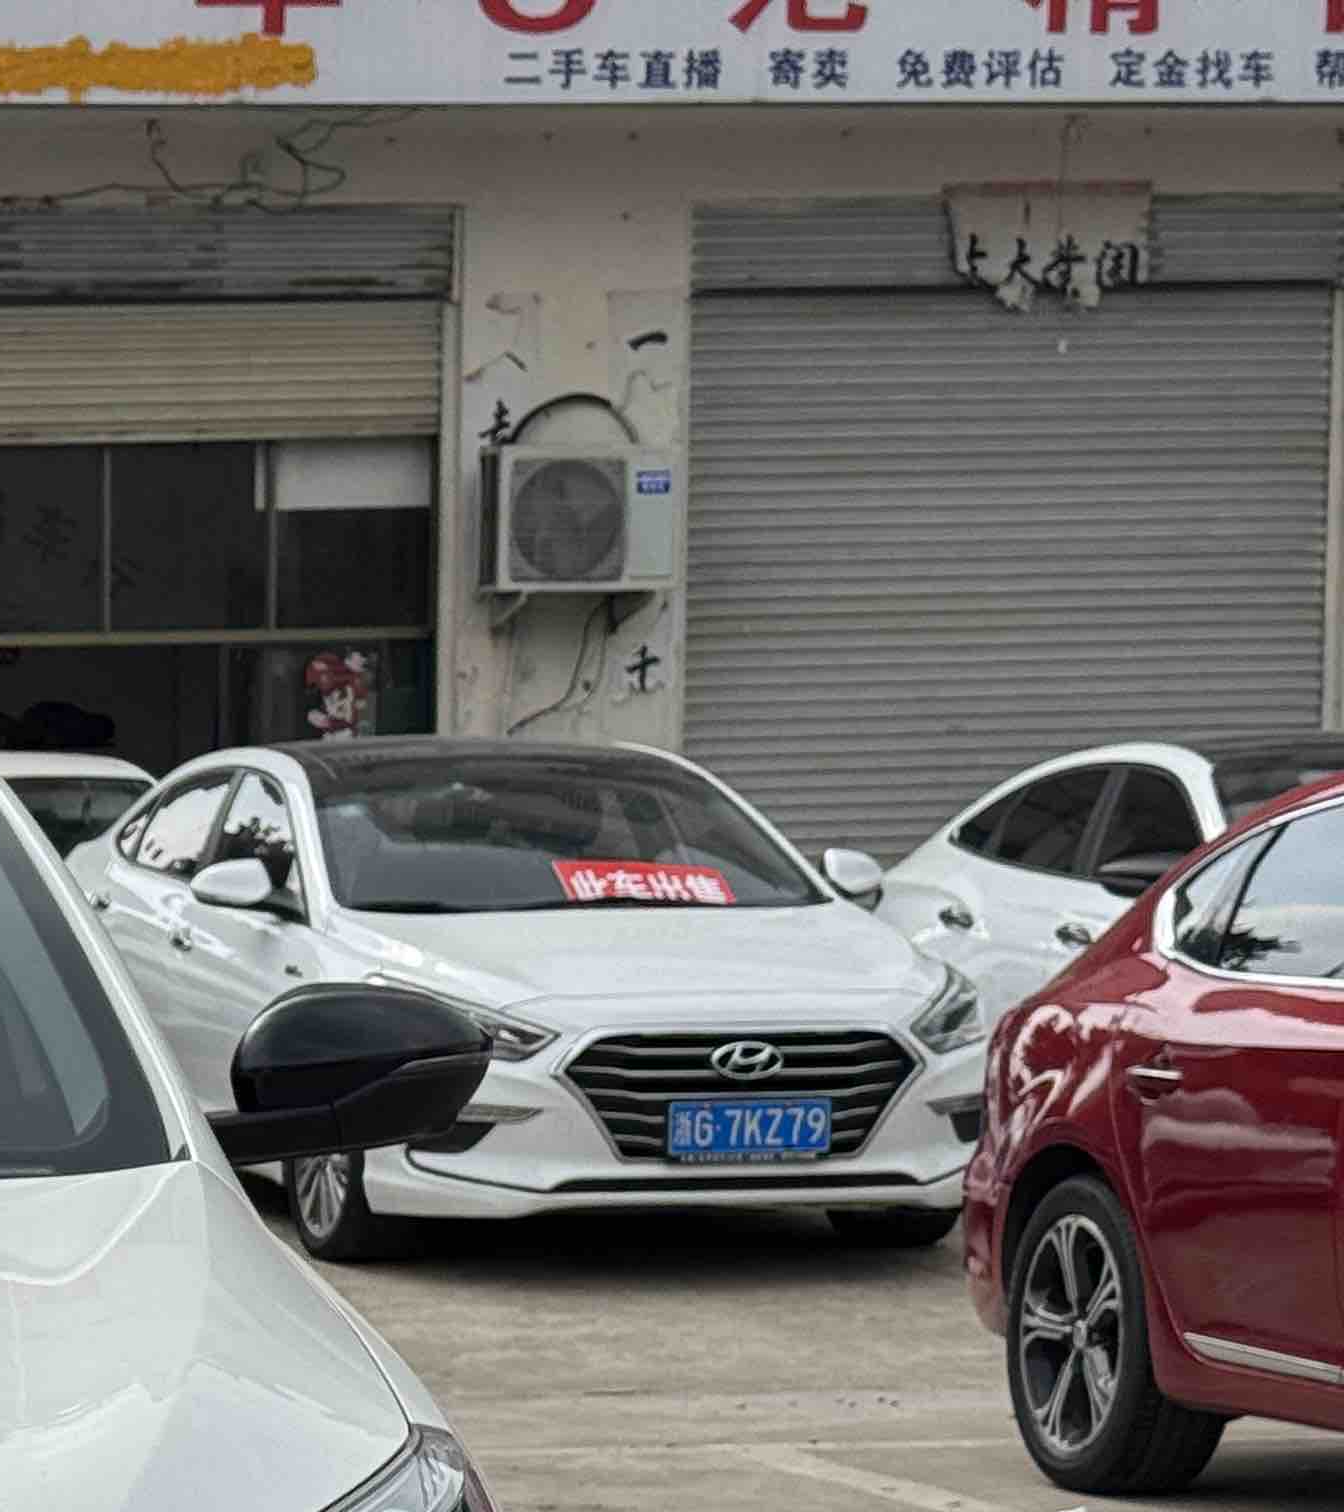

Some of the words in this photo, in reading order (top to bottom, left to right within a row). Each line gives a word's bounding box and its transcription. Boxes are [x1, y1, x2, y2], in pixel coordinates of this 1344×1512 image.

[504, 48, 722, 90] 二手车直播
[769, 48, 849, 89] 寄卖
[896, 48, 1065, 89] 免费评估
[1110, 48, 1275, 89] 定金找车
